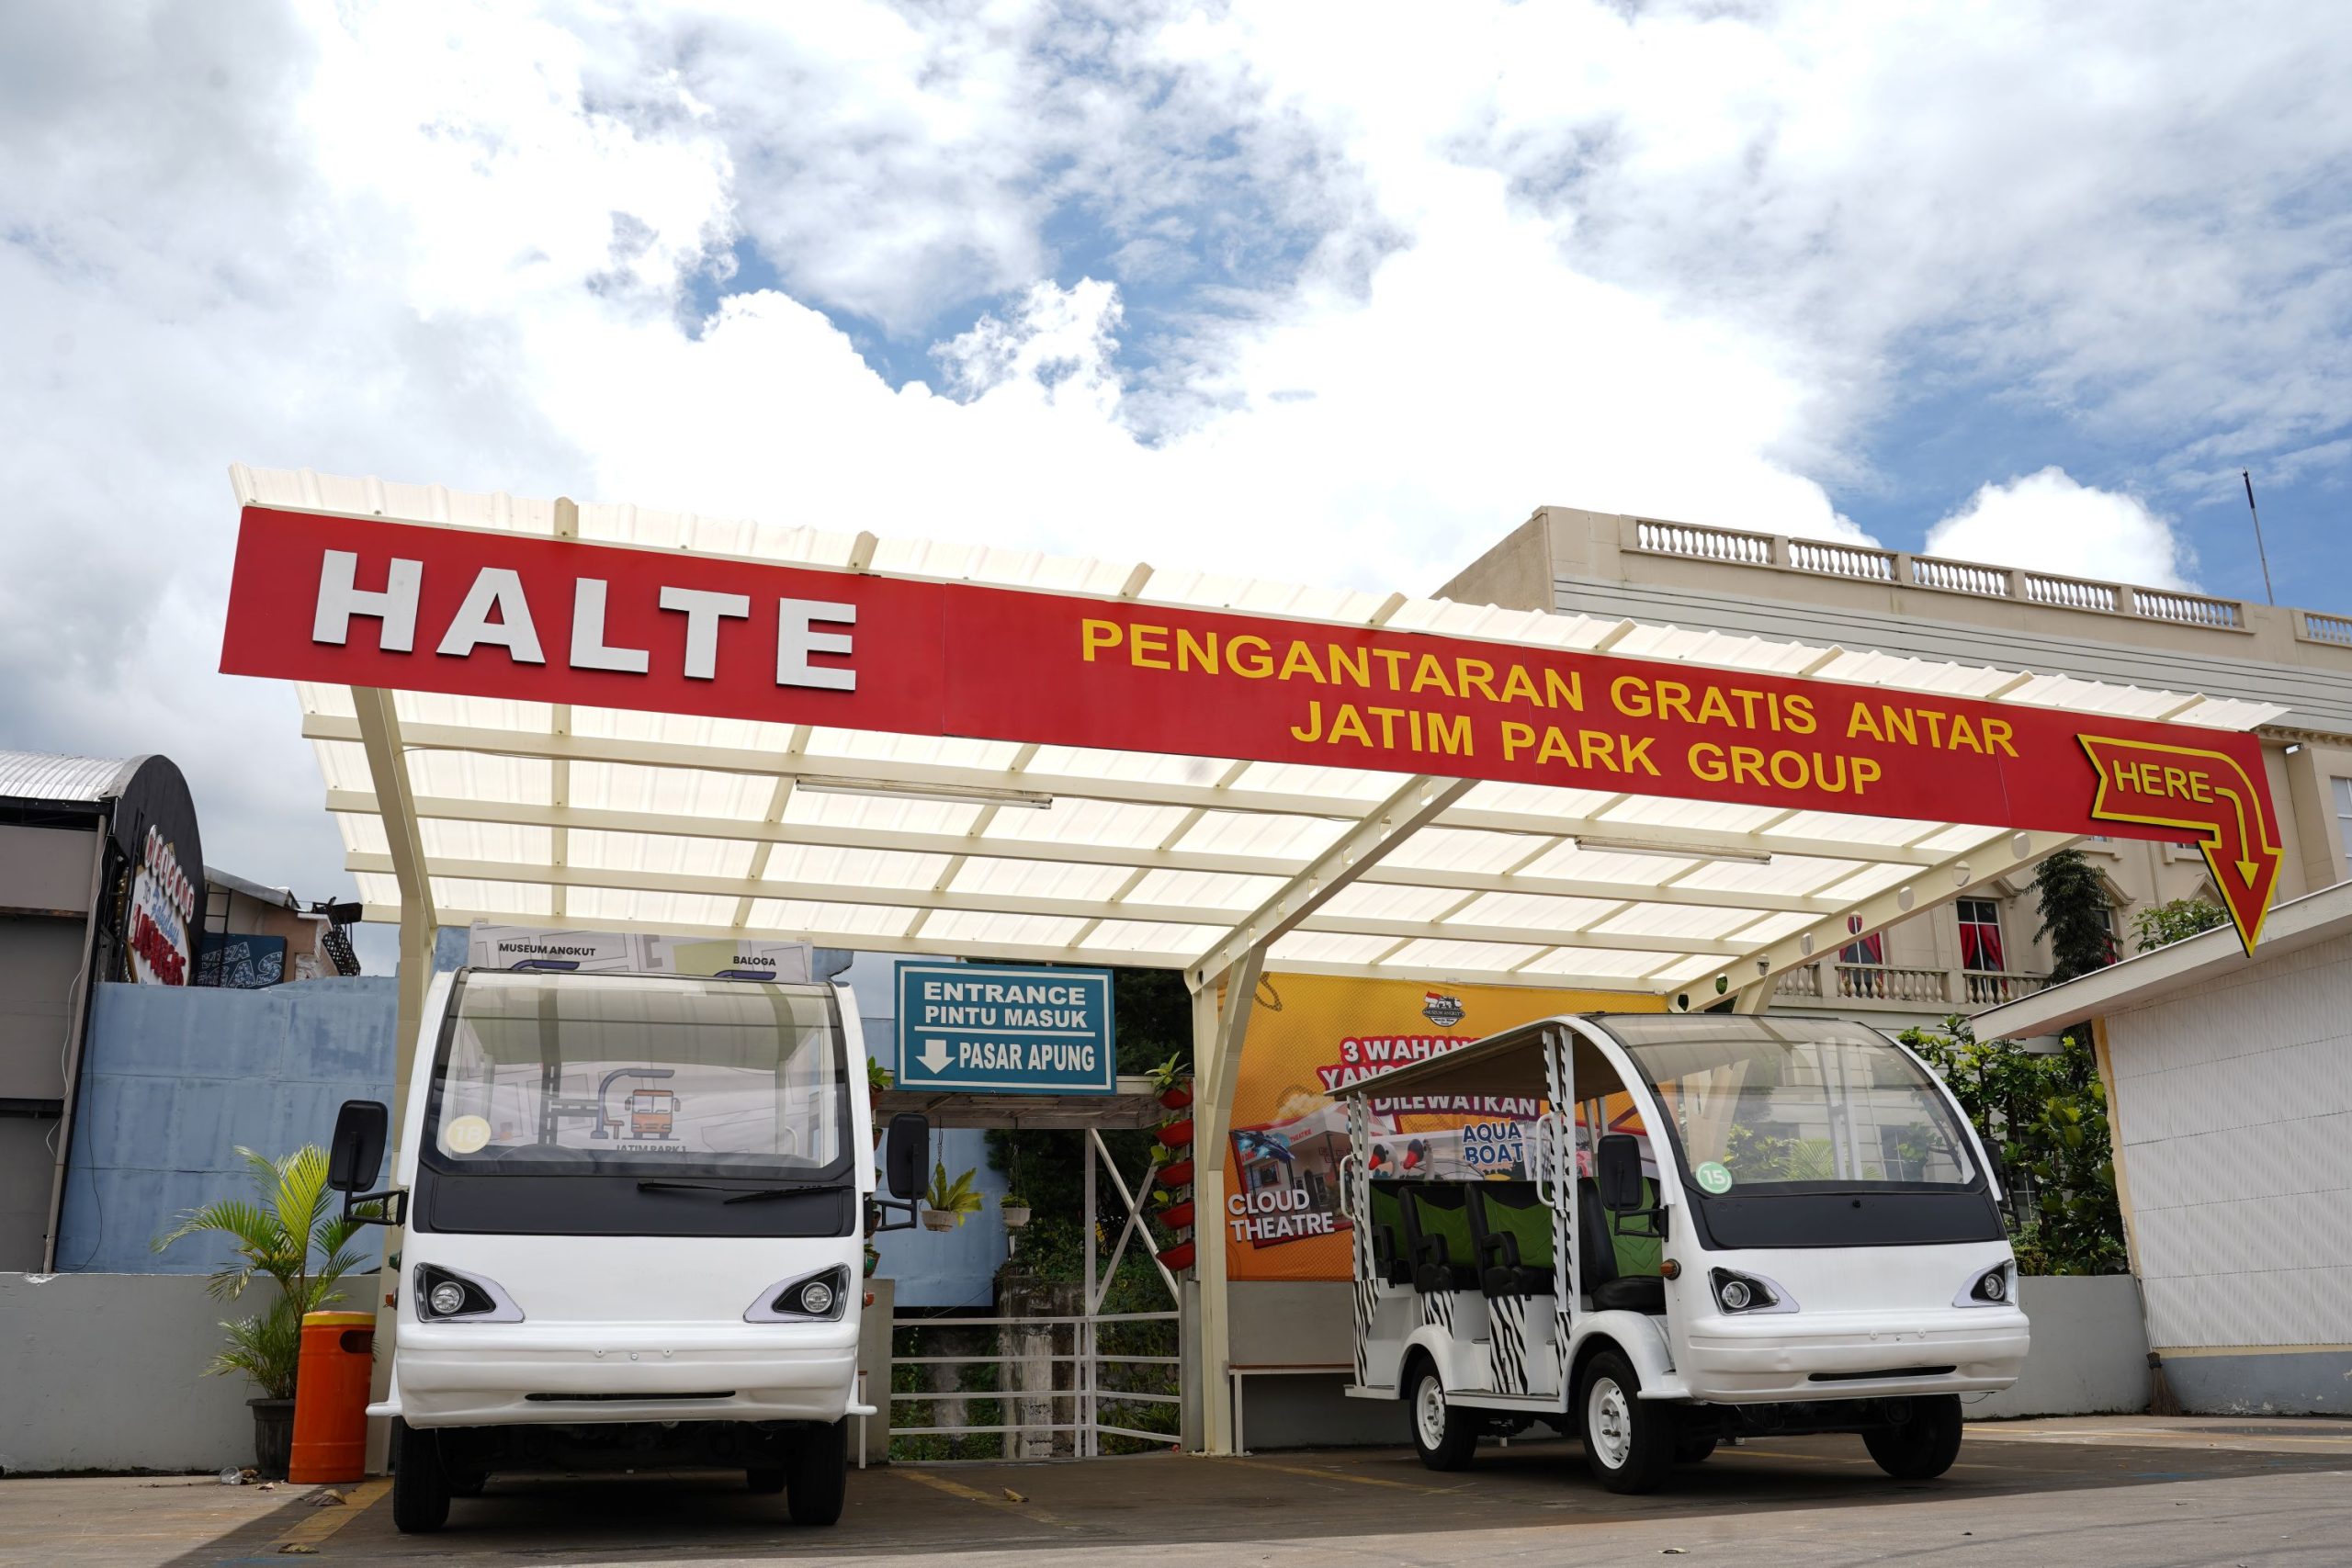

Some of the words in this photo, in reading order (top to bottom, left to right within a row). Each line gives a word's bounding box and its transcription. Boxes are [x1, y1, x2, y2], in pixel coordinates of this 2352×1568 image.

[311, 549, 856, 691] HALTE
[1082, 618, 1584, 712] PENGANTARAN
[1611, 676, 1817, 735] GRATIS
[1846, 702, 2020, 758] ANTAR
[1290, 701, 1474, 757] JATIM
[1501, 720, 1661, 776] PARK
[1688, 742, 1882, 795] GROUP
[2113, 760, 2214, 804] HERE
[499, 942, 548, 954] MUSEUM
[549, 945, 596, 956] ANGKUT
[733, 955, 776, 967] BALOGA
[924, 982, 1086, 1005] ENTRANCE
[925, 1006, 997, 1026] PINTU
[1004, 1009, 1088, 1029] MASUK
[959, 1042, 1023, 1070] PASAR
[1028, 1043, 1095, 1072] APUNG
[1343, 1041, 1359, 1062] 3
[1463, 1122, 1522, 1143] AQUA
[1464, 1143, 1523, 1165] BOAT
[1702, 1169, 1725, 1185] 15
[1227, 1189, 1311, 1215] CLOUD
[1229, 1212, 1336, 1242] THEATRE
